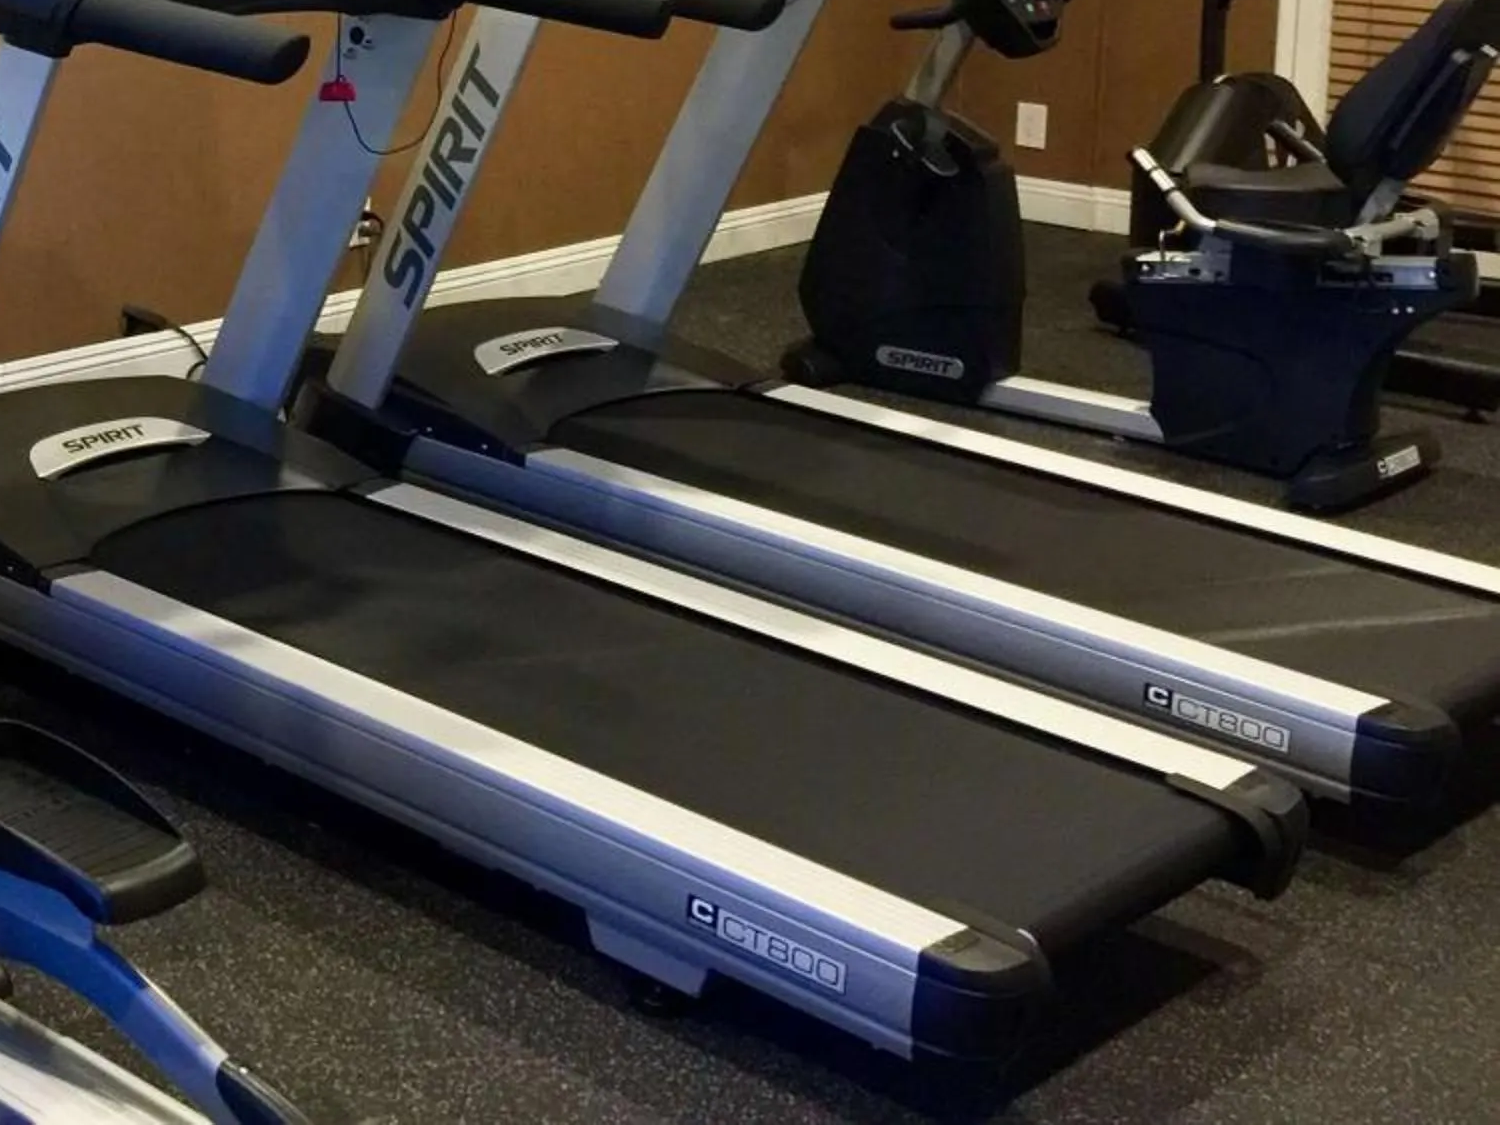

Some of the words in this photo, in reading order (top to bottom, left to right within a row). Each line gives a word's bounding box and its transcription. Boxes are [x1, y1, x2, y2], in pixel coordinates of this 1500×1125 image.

[383, 42, 500, 310] SPIRIT
[500, 332, 564, 357] SPIRIT
[62, 424, 145, 454] SPIRIT
[1177, 698, 1285, 748] CT800
[723, 915, 840, 986] CT800
